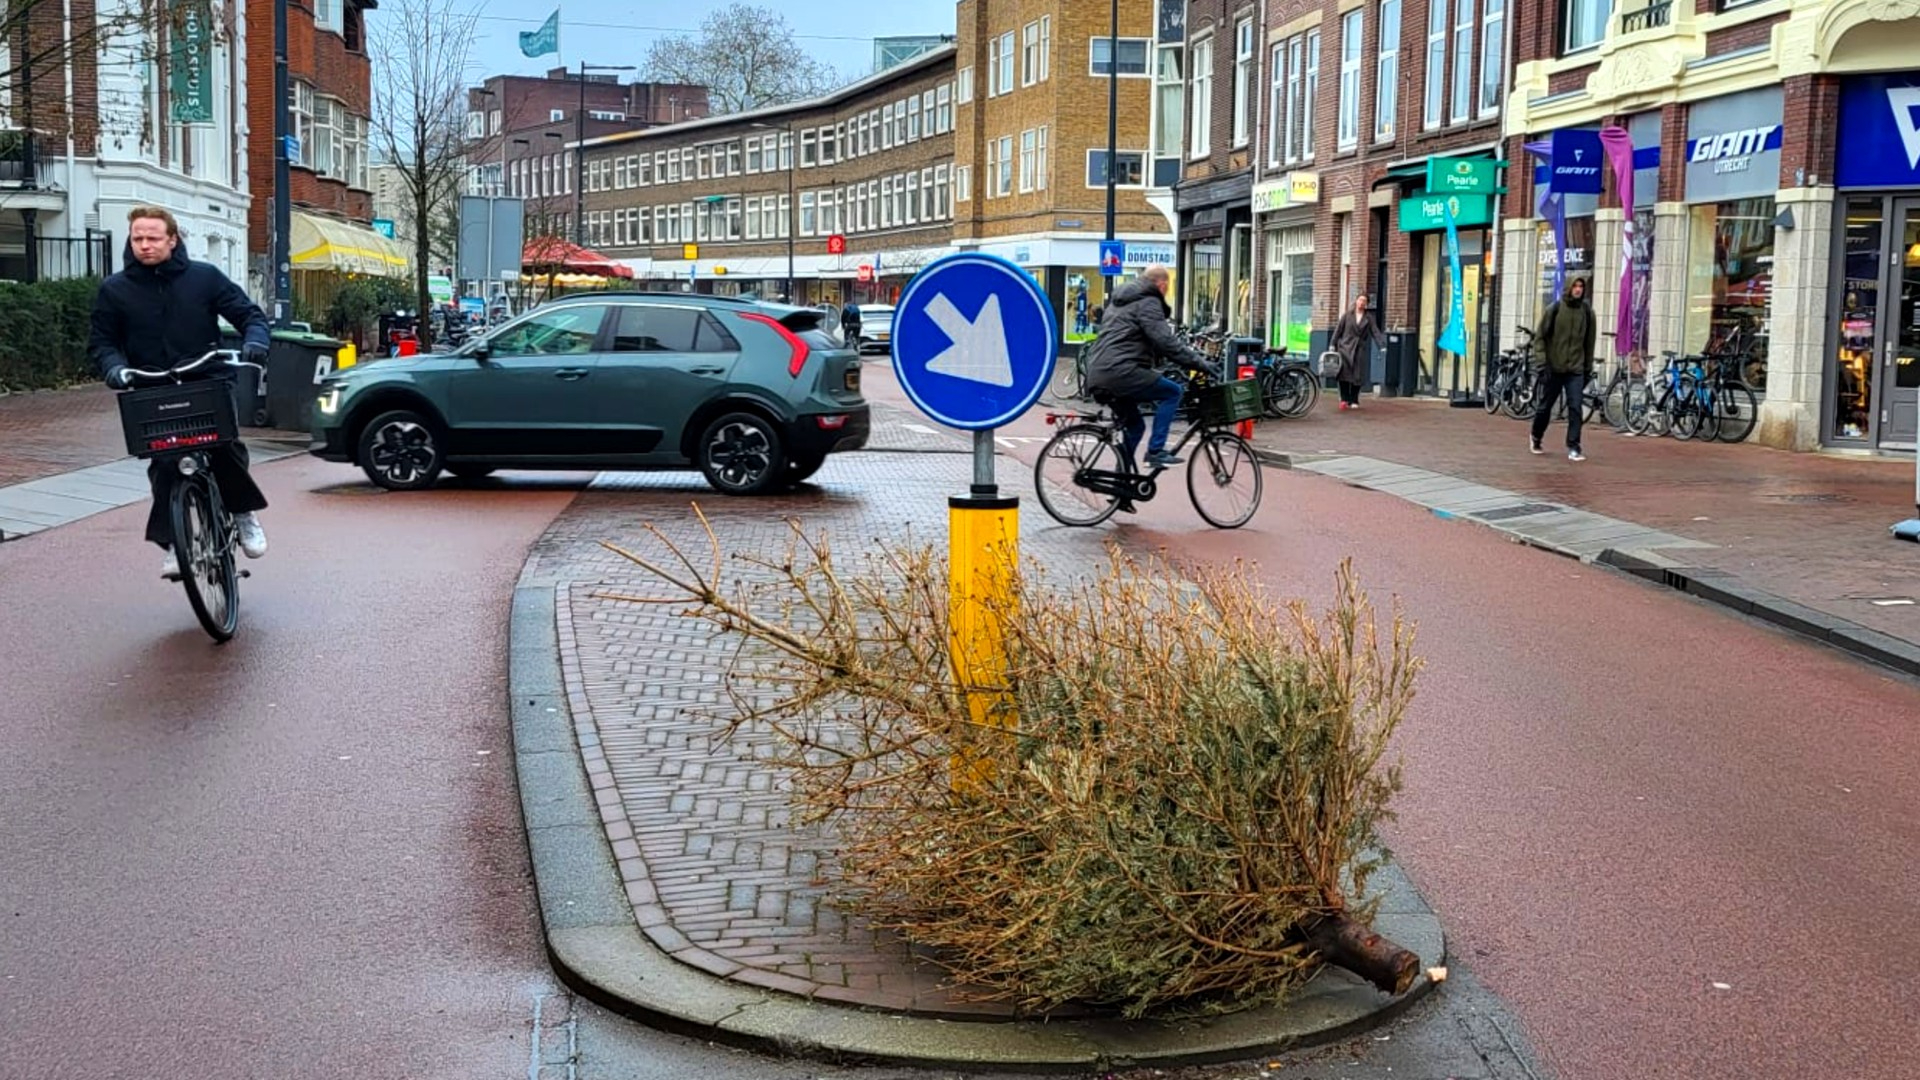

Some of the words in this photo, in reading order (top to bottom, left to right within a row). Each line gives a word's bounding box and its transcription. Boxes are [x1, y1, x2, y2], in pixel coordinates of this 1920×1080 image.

[1691, 124, 1778, 164] GIANT
[1555, 165, 1600, 176] GIANT
[1714, 156, 1752, 175] UTRECHT
[1447, 174, 1479, 186] Pearle
[1422, 200, 1444, 217] Pearle
